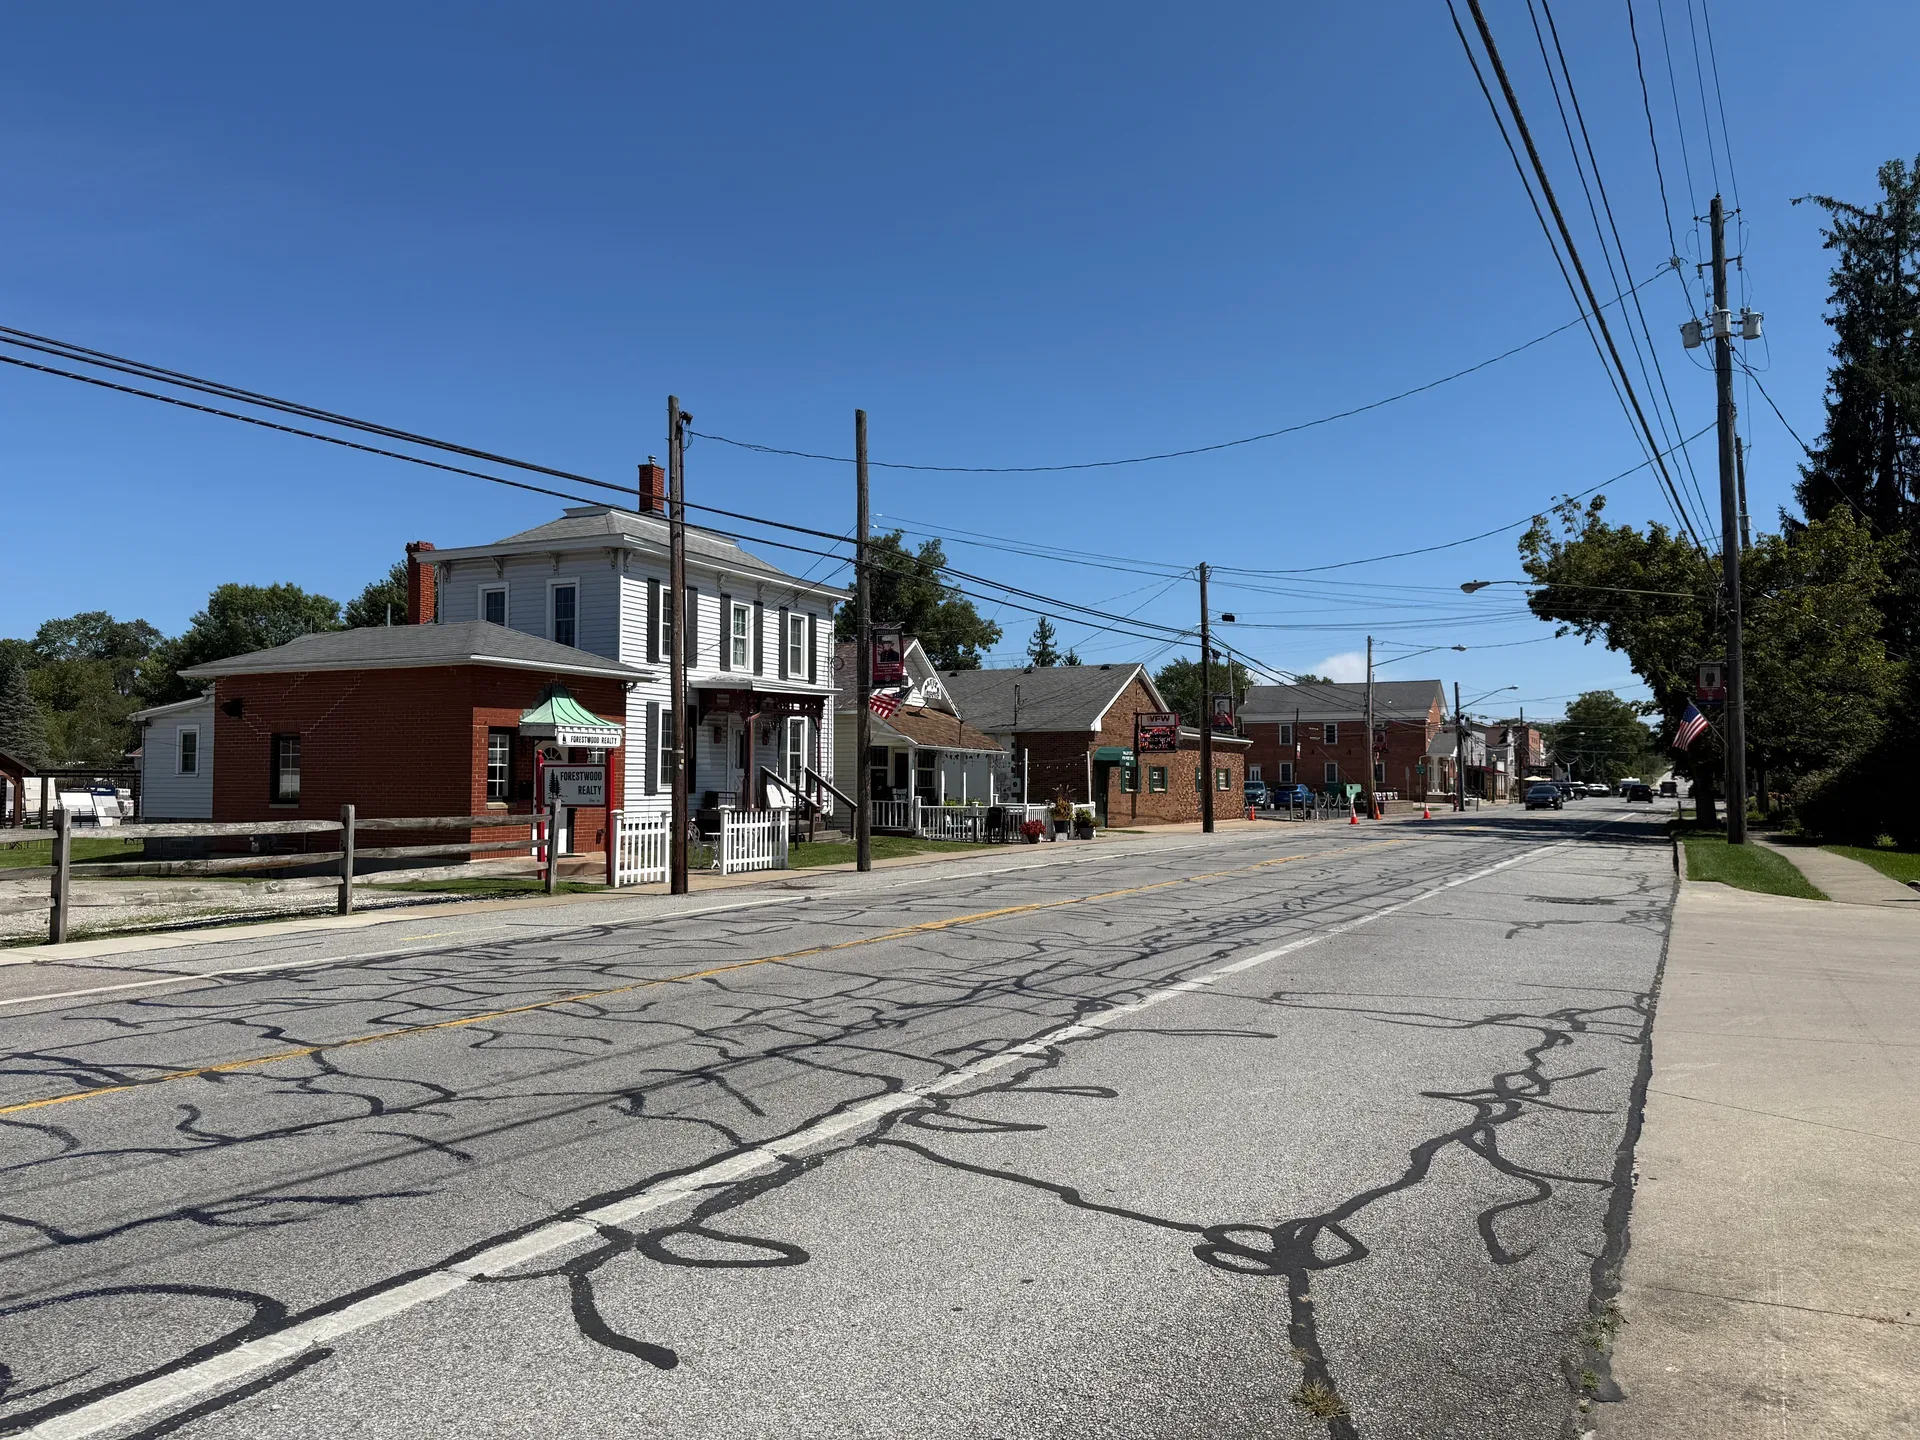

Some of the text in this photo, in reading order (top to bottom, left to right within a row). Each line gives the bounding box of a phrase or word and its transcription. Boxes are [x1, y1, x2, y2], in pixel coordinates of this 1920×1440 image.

[570, 735, 600, 744] FORESTWOOD
[560, 771, 602, 781] FORESTWOOD
[578, 786, 602, 796] REALTY
